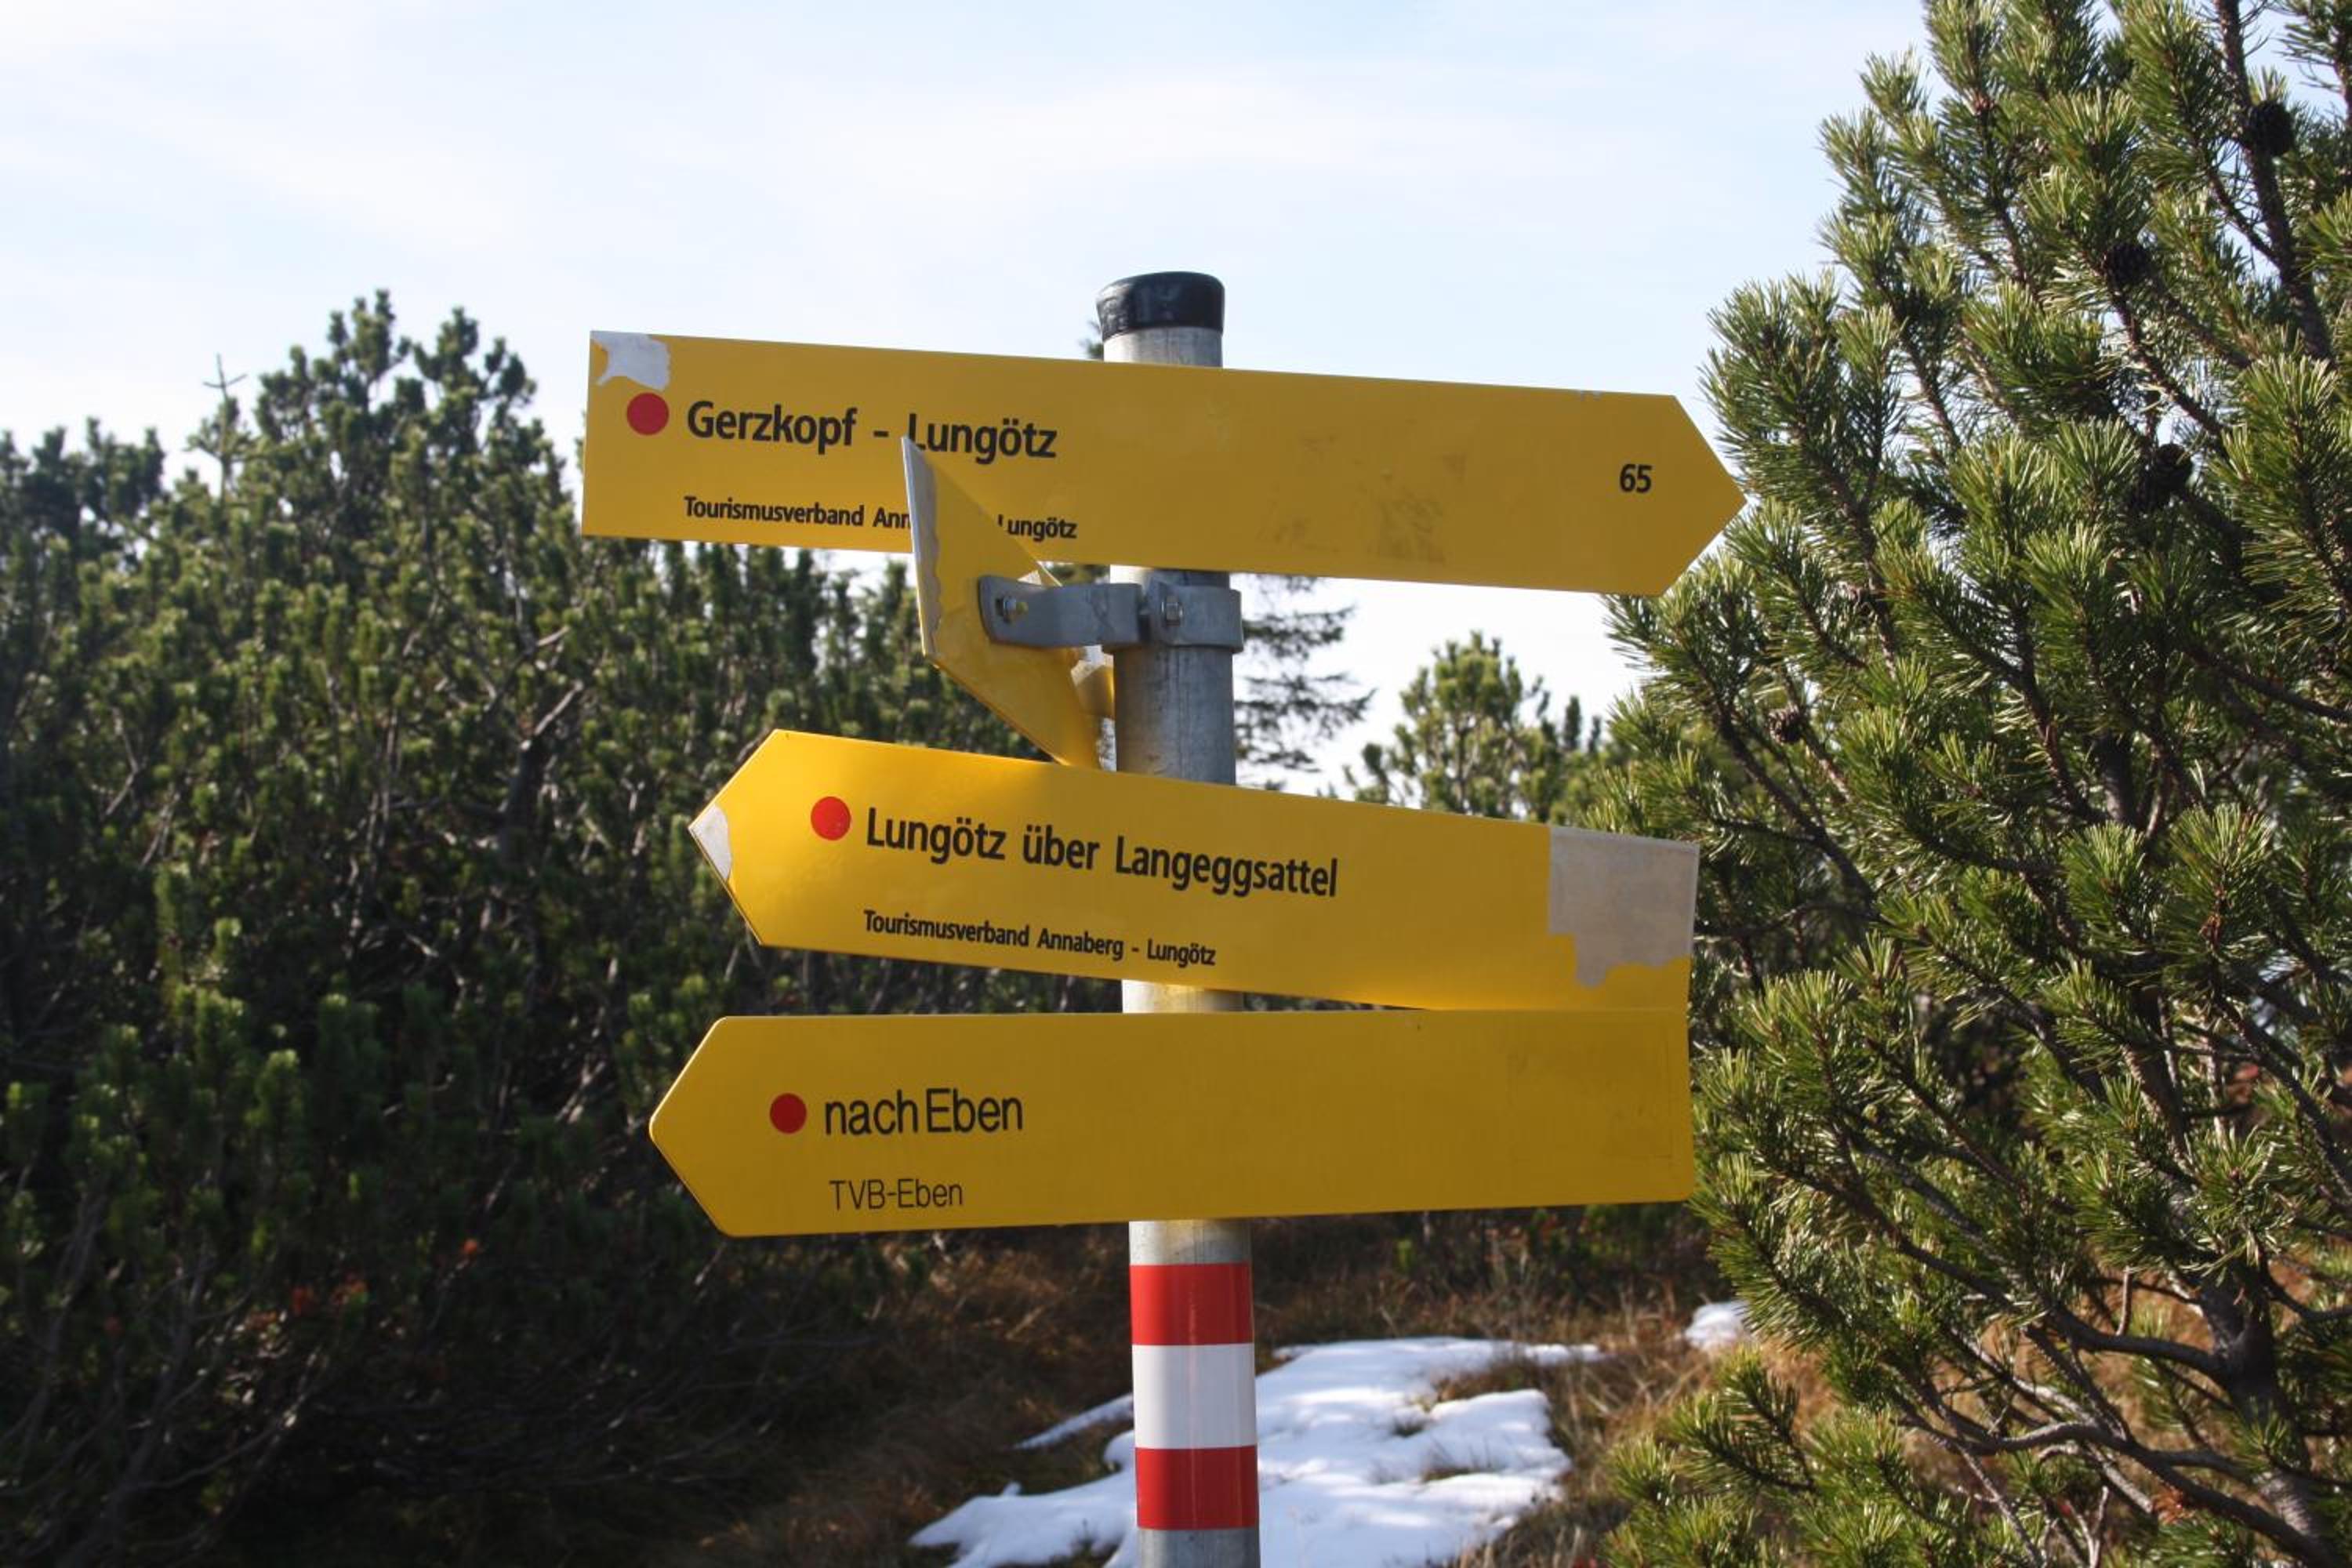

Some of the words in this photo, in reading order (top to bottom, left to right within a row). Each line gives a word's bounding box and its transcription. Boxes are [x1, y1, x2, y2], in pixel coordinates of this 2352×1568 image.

[688, 401, 858, 455] Gerzkopf
[908, 413, 1058, 465] Lungötz
[1620, 463, 1653, 493] 65
[684, 495, 865, 527] Tourismusverband
[867, 808, 1007, 865] Lungötz
[1023, 825, 1101, 870] über
[1116, 836, 1338, 898] Langeggsattel
[864, 910, 1030, 947] Tourismusverband
[1037, 928, 1124, 962] Annaberg
[1148, 939, 1216, 968] Lungötz
[829, 1178, 963, 1210] TVB-Eben
